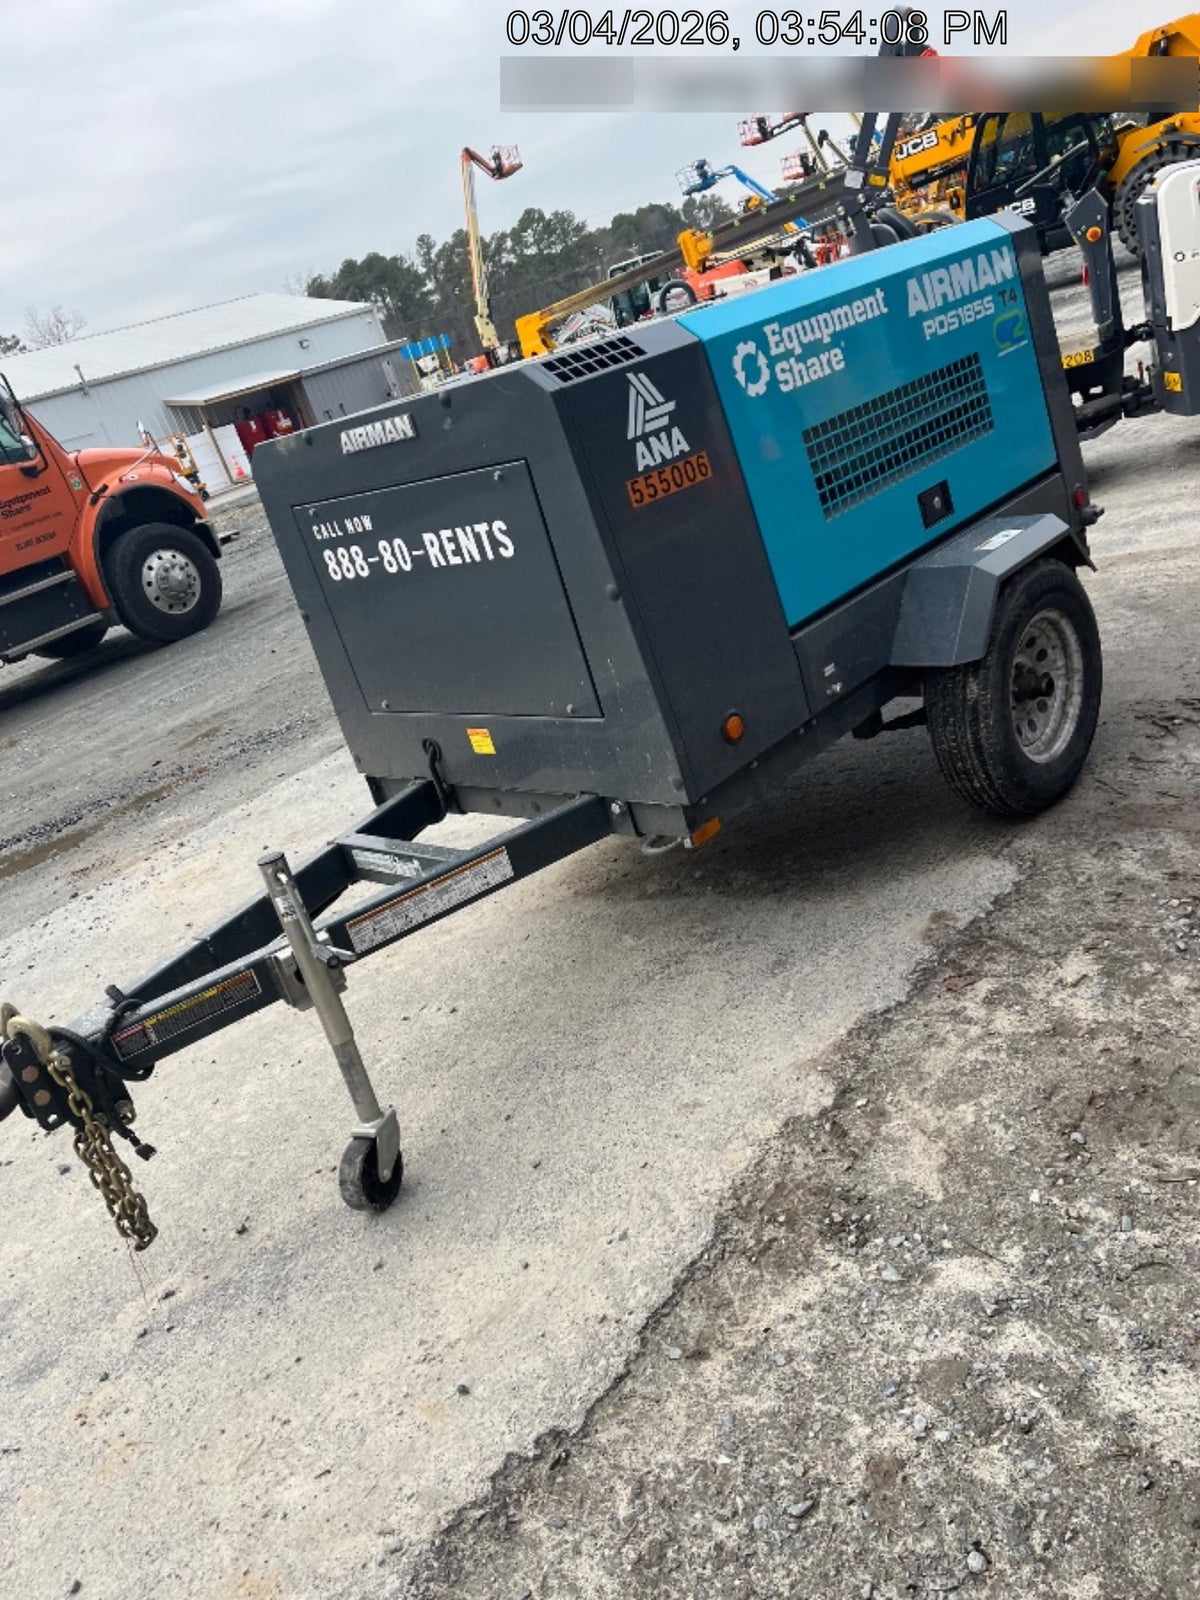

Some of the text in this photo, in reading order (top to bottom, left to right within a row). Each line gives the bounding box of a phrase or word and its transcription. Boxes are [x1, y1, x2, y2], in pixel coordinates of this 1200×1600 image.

[896, 131, 938, 160] JCB
[906, 246, 1014, 318] AIRMAN
[763, 287, 888, 355] Equipment
[922, 286, 1018, 340] PDS185S T4
[774, 347, 846, 393] Share
[340, 414, 416, 454] AIRMAN
[636, 426, 690, 472] ANA
[630, 454, 709, 504] 555006
[312, 515, 373, 540] CALL NOW
[323, 520, 515, 581] 888-80-RENTS
